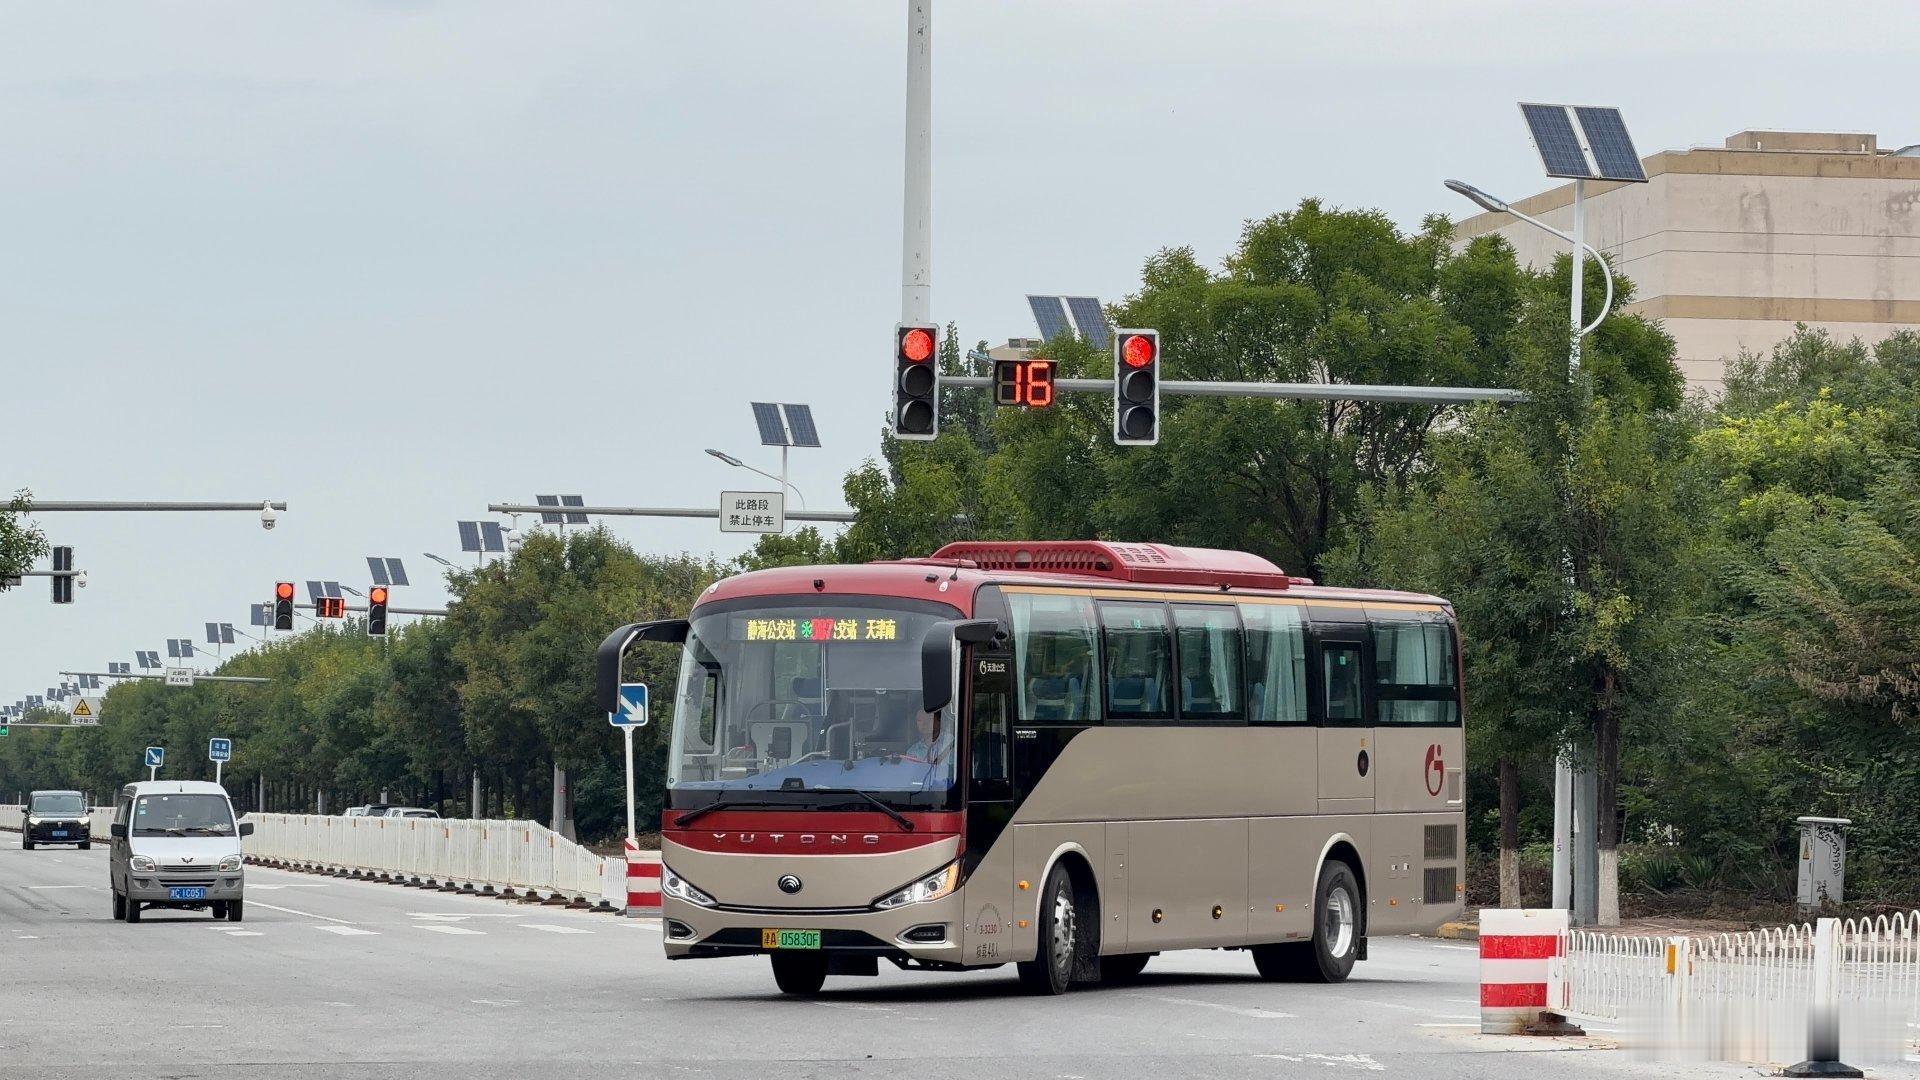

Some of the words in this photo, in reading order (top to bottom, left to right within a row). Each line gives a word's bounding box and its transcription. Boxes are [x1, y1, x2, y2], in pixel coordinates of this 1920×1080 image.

[1015, 362, 1051, 406] 16
[735, 499, 769, 511] 此路段
[729, 514, 774, 526] 禁止停车
[747, 619, 797, 640] 静海公交站
[865, 619, 896, 640] 天津南
[712, 833, 880, 844] YUTONG
